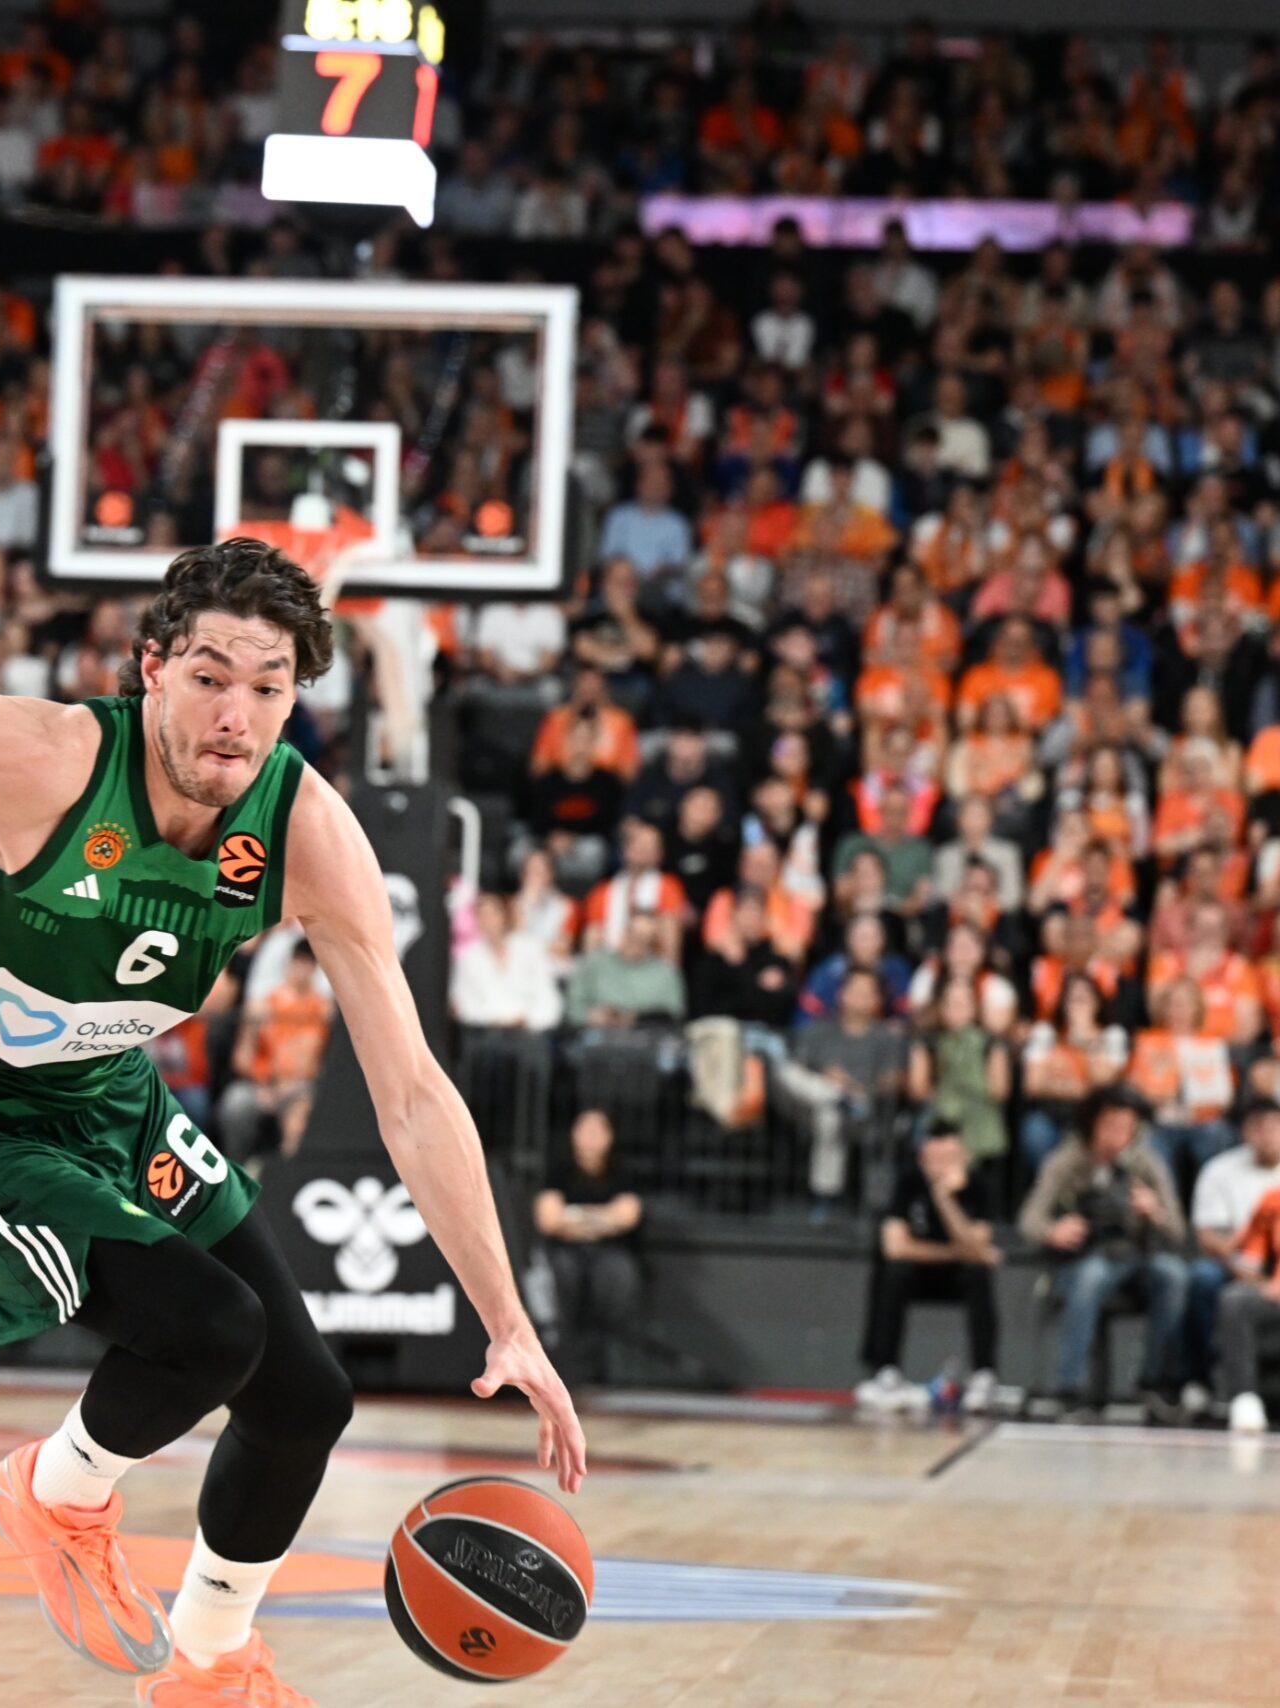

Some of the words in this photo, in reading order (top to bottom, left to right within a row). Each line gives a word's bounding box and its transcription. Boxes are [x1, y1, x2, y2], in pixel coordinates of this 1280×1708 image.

[315, 49, 382, 136] 7
[115, 929, 180, 986] 6
[76, 1019, 155, 1039] Ομάδα
[166, 1112, 229, 1185] 6
